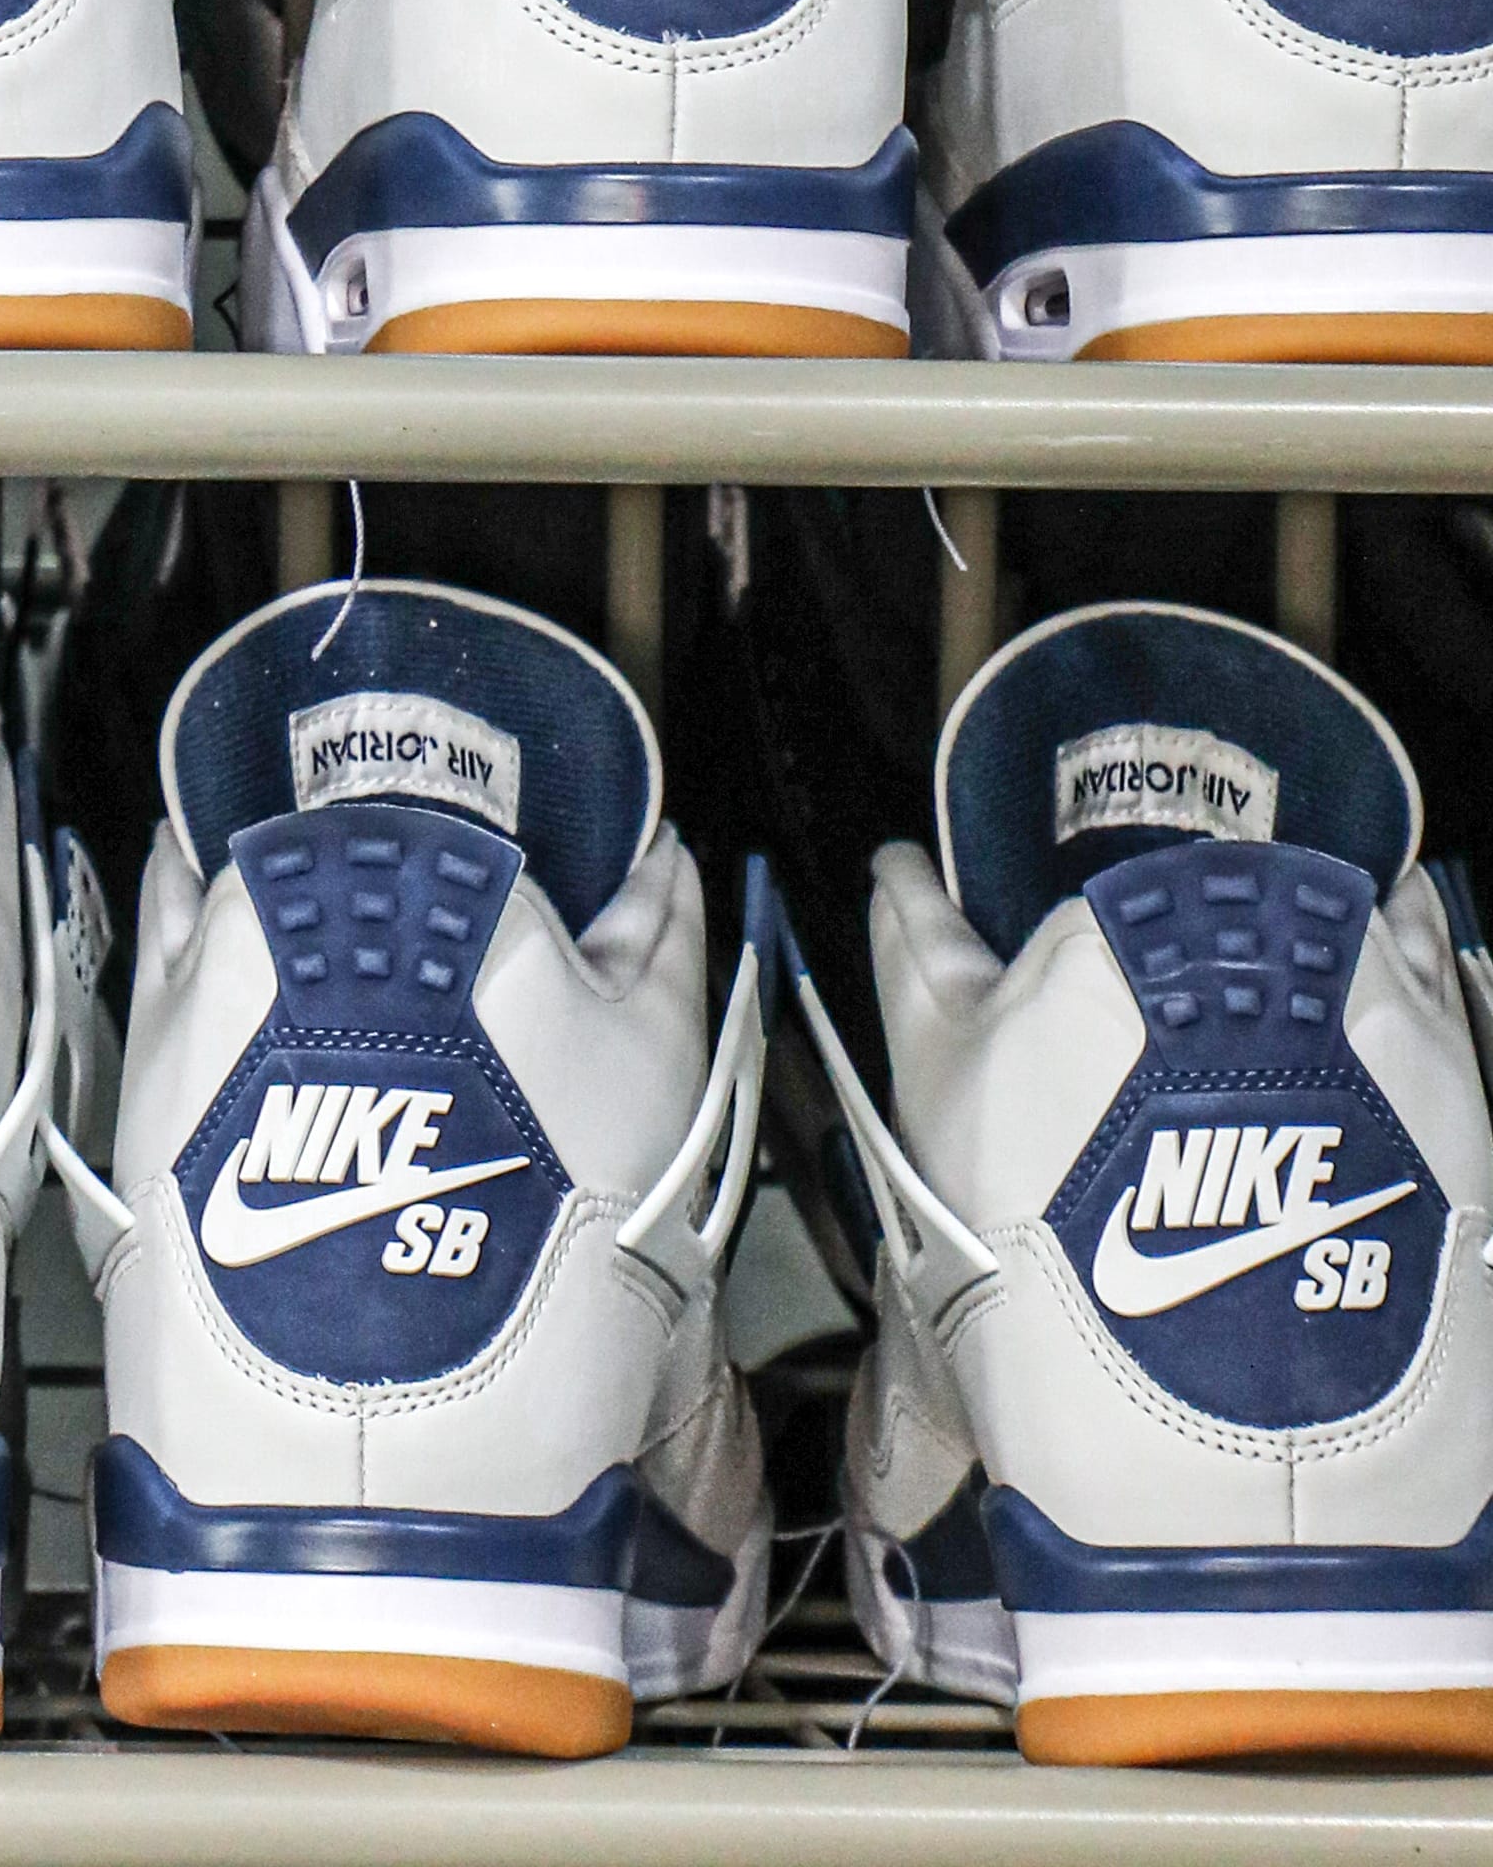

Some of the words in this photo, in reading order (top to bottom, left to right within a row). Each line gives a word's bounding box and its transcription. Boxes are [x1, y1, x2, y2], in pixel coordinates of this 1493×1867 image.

[312, 731, 438, 775] JORDAN
[448, 741, 493, 787] AIR
[1074, 759, 1198, 803] JORDAN
[237, 1083, 452, 1183] NIKE
[1129, 1125, 1340, 1231] NIKE
[379, 1203, 492, 1278] SB
[1291, 1236, 1393, 1311] SB
